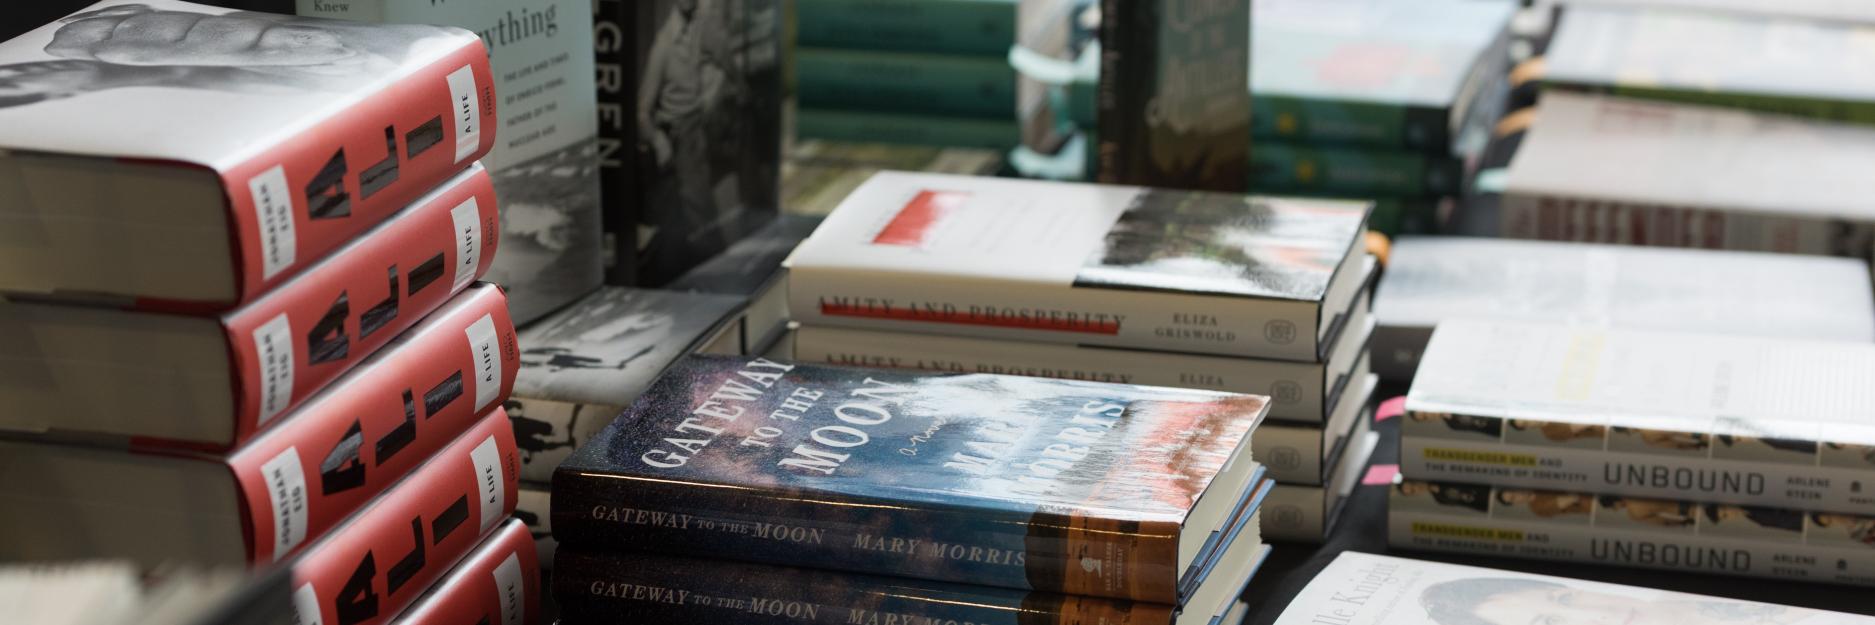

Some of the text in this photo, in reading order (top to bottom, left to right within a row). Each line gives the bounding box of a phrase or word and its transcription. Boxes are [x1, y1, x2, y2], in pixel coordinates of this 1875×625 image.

[313, 0, 350, 13] Knew
[462, 94, 471, 122] LIFE
[304, 114, 444, 220] ALI
[307, 252, 445, 366] ALI
[816, 296, 1126, 329] AMITY AND PROSPERITY
[1173, 313, 1218, 326] ELIZA
[1154, 328, 1236, 342] GRISWOLD
[482, 342, 491, 371] LIFE
[1180, 373, 1224, 386] ELIZA
[641, 357, 796, 469] GATEWAY
[740, 386, 825, 448] TO THE
[777, 377, 917, 475] MOON
[320, 369, 463, 496] ALI
[1425, 449, 1562, 468] TRANSGENDER MEN AND
[1425, 462, 1588, 483] THE REMAKING OF IDENTITY
[485, 464, 495, 495] LIFE
[1604, 462, 1765, 496] UNBOUND
[1786, 476, 1831, 489] ARLENE
[592, 505, 826, 545] GATEWAY TO THE MOON
[1498, 530, 1523, 541] MEN
[1527, 533, 1550, 543] AND
[335, 493, 469, 625] ALI
[854, 534, 1027, 566] MARY MORRIS
[1591, 538, 1752, 573] UNBOUND
[590, 580, 820, 621] GATEWAY TO THE MOON
[1330, 563, 1399, 606] Knight
